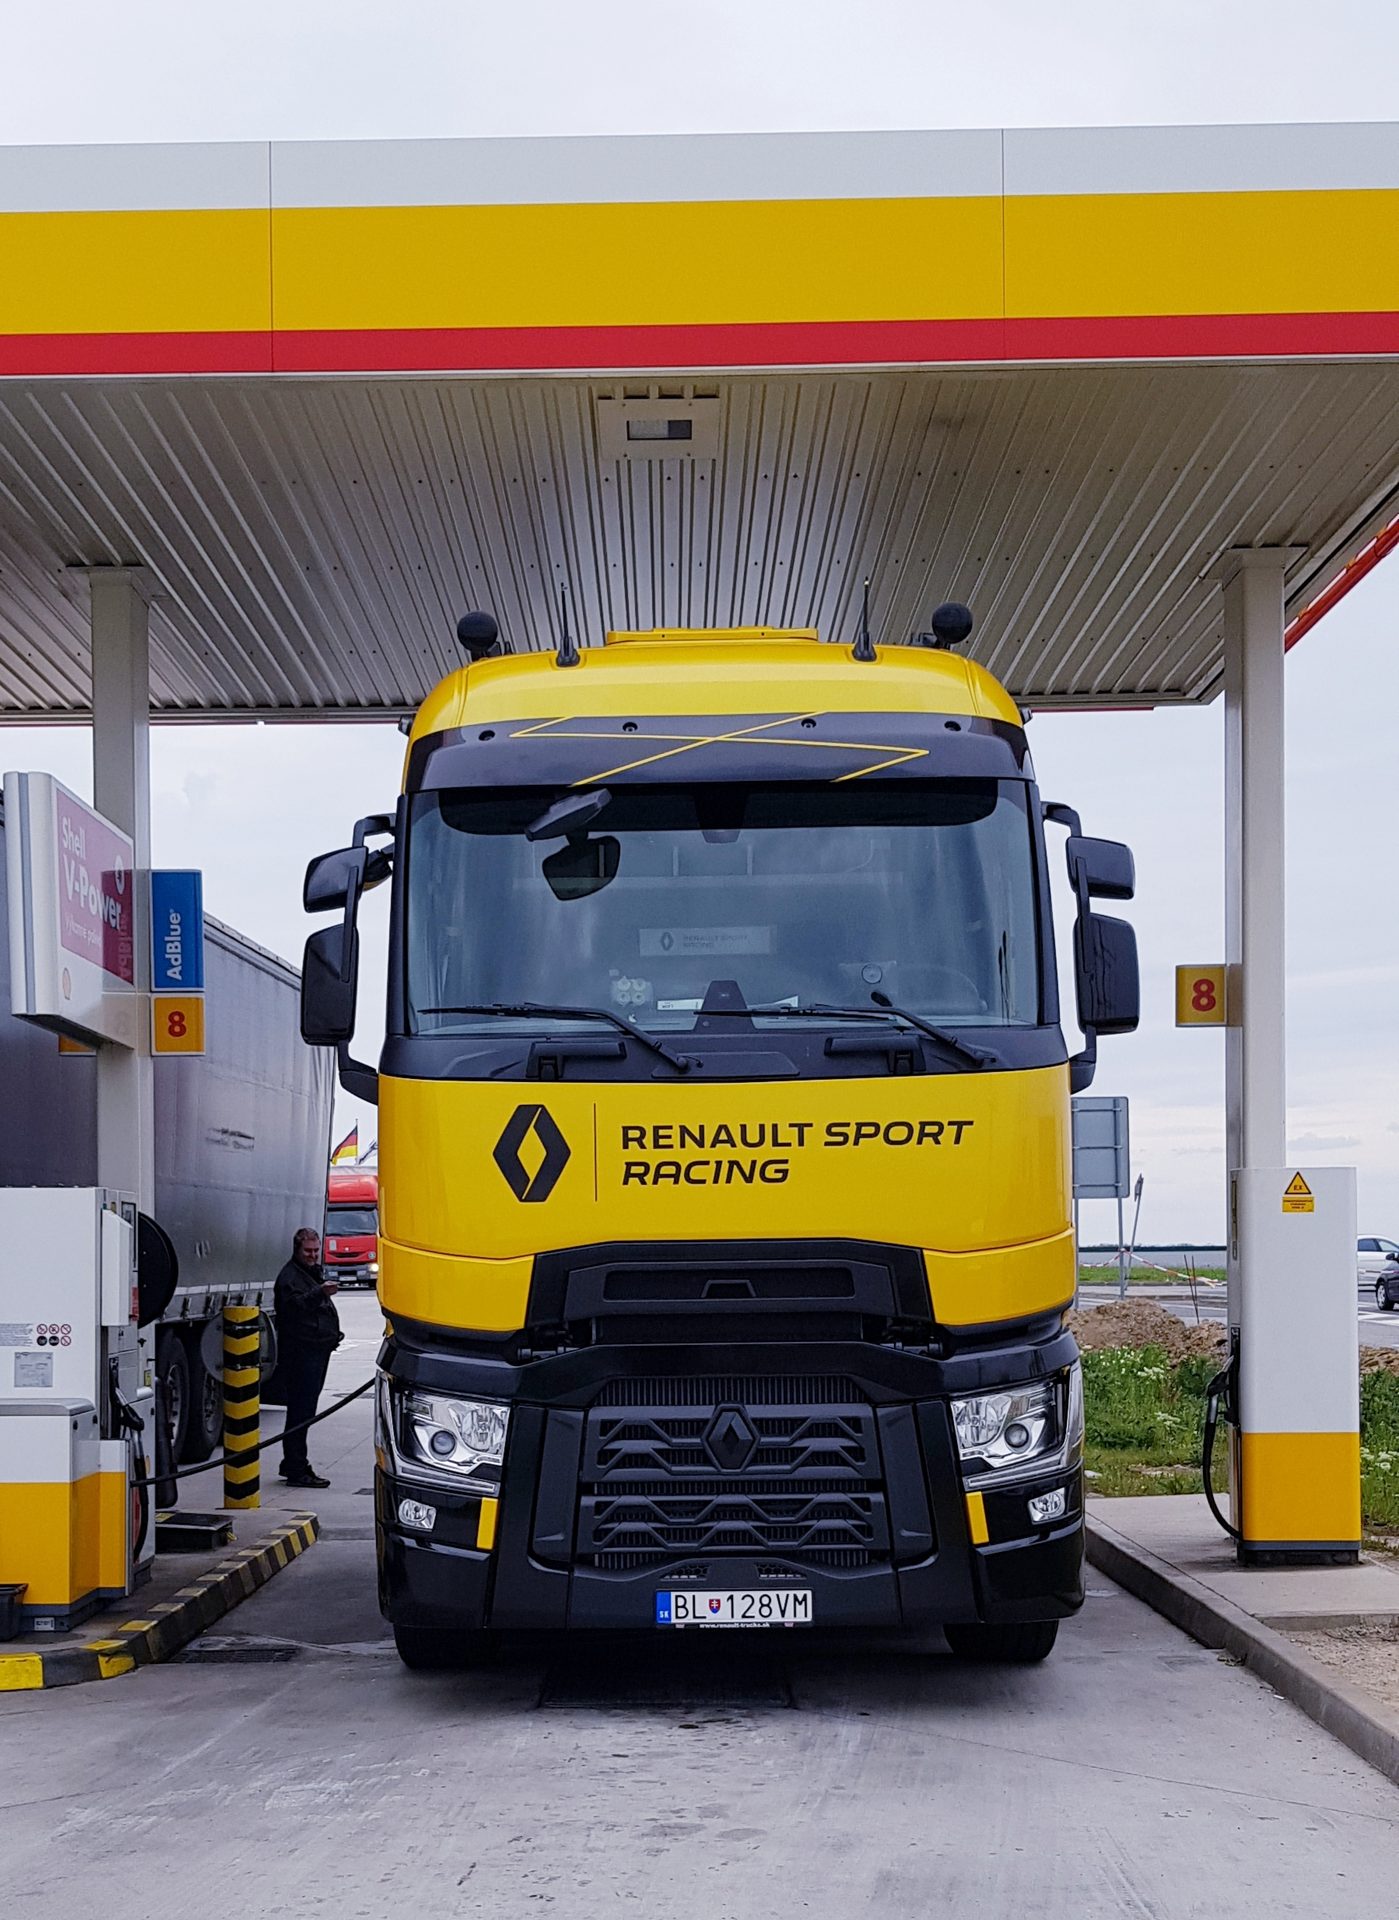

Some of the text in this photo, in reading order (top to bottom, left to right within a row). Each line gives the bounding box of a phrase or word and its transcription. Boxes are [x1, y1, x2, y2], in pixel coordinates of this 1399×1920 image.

[62, 816, 86, 861] Shell
[63, 854, 122, 931] V-Power
[164, 911, 182, 980] AdBlue
[1192, 978, 1217, 1012] 8
[168, 1011, 187, 1037] 8
[621, 1120, 974, 1150] RENAULT SPORT
[622, 1159, 789, 1186] RACING
[659, 1593, 808, 1619] SK BL 128VM
